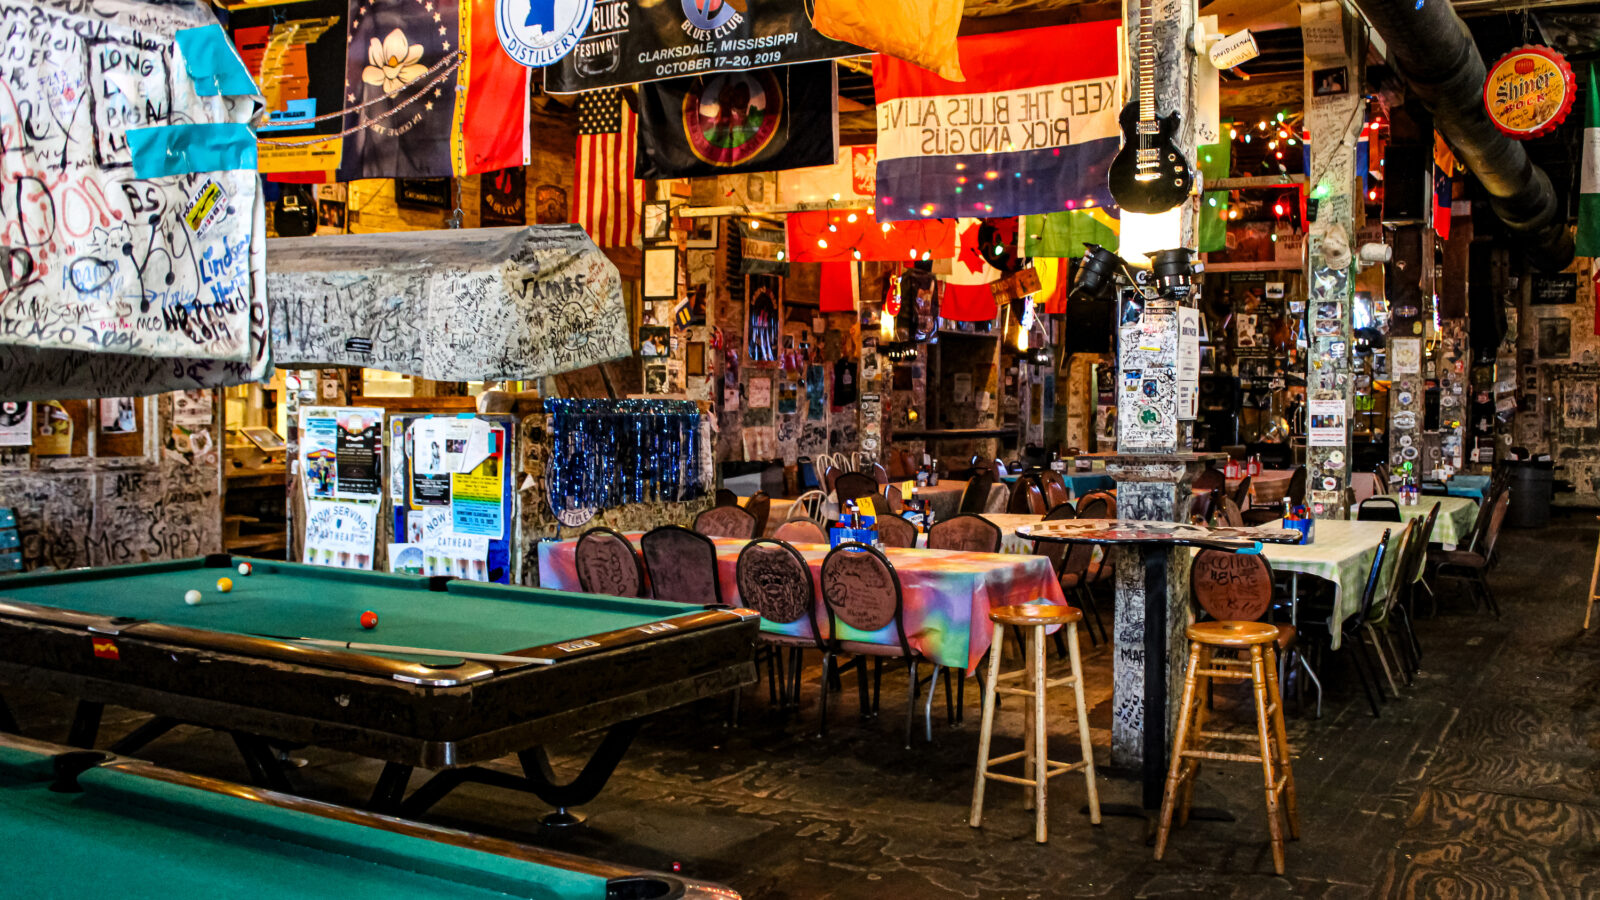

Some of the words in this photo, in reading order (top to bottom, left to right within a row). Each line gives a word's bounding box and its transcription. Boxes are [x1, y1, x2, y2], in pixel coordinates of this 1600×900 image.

[592, 2, 629, 32] BLUES
[681, 19, 711, 41] BLUES
[714, 13, 744, 39] CLUB
[507, 28, 578, 63] DISTILLERY
[573, 36, 619, 57] FESTIVAL
[638, 41, 717, 63] CLARKSDALE,
[720, 32, 798, 52] MISSISSIPPI
[656, 58, 711, 76] OCTOBER
[752, 51, 782, 64] 2019
[1496, 71, 1556, 104] Shiner
[311, 508, 331, 524] NOW
[333, 506, 368, 530] SERVING
[426, 514, 446, 532] NOW
[437, 537, 473, 548] CATHEAD
